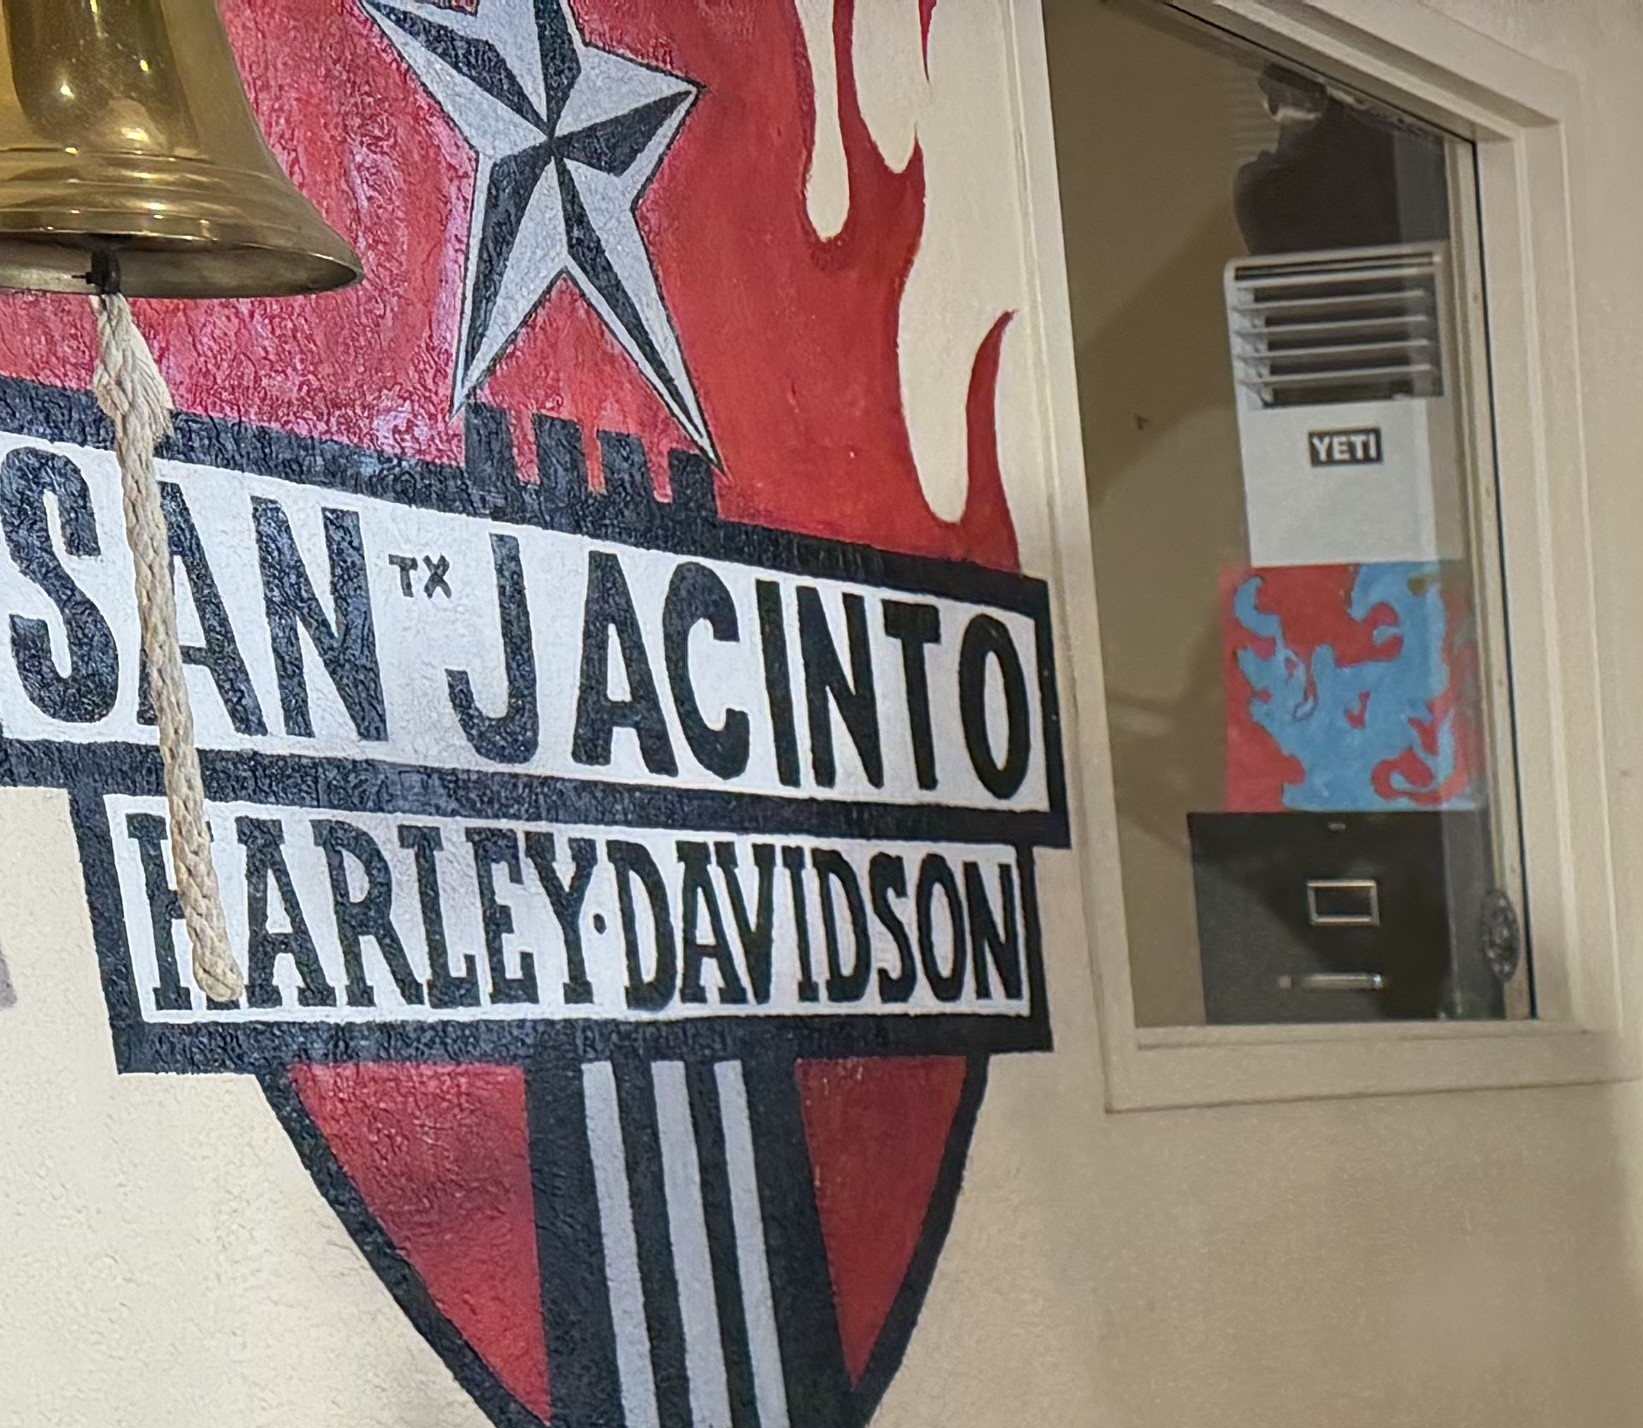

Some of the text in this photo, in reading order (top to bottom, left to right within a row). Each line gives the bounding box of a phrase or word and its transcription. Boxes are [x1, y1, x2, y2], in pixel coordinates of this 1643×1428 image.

[1312, 432, 1377, 462] YETI
[2, 447, 1030, 797] SAN TX JACINTO
